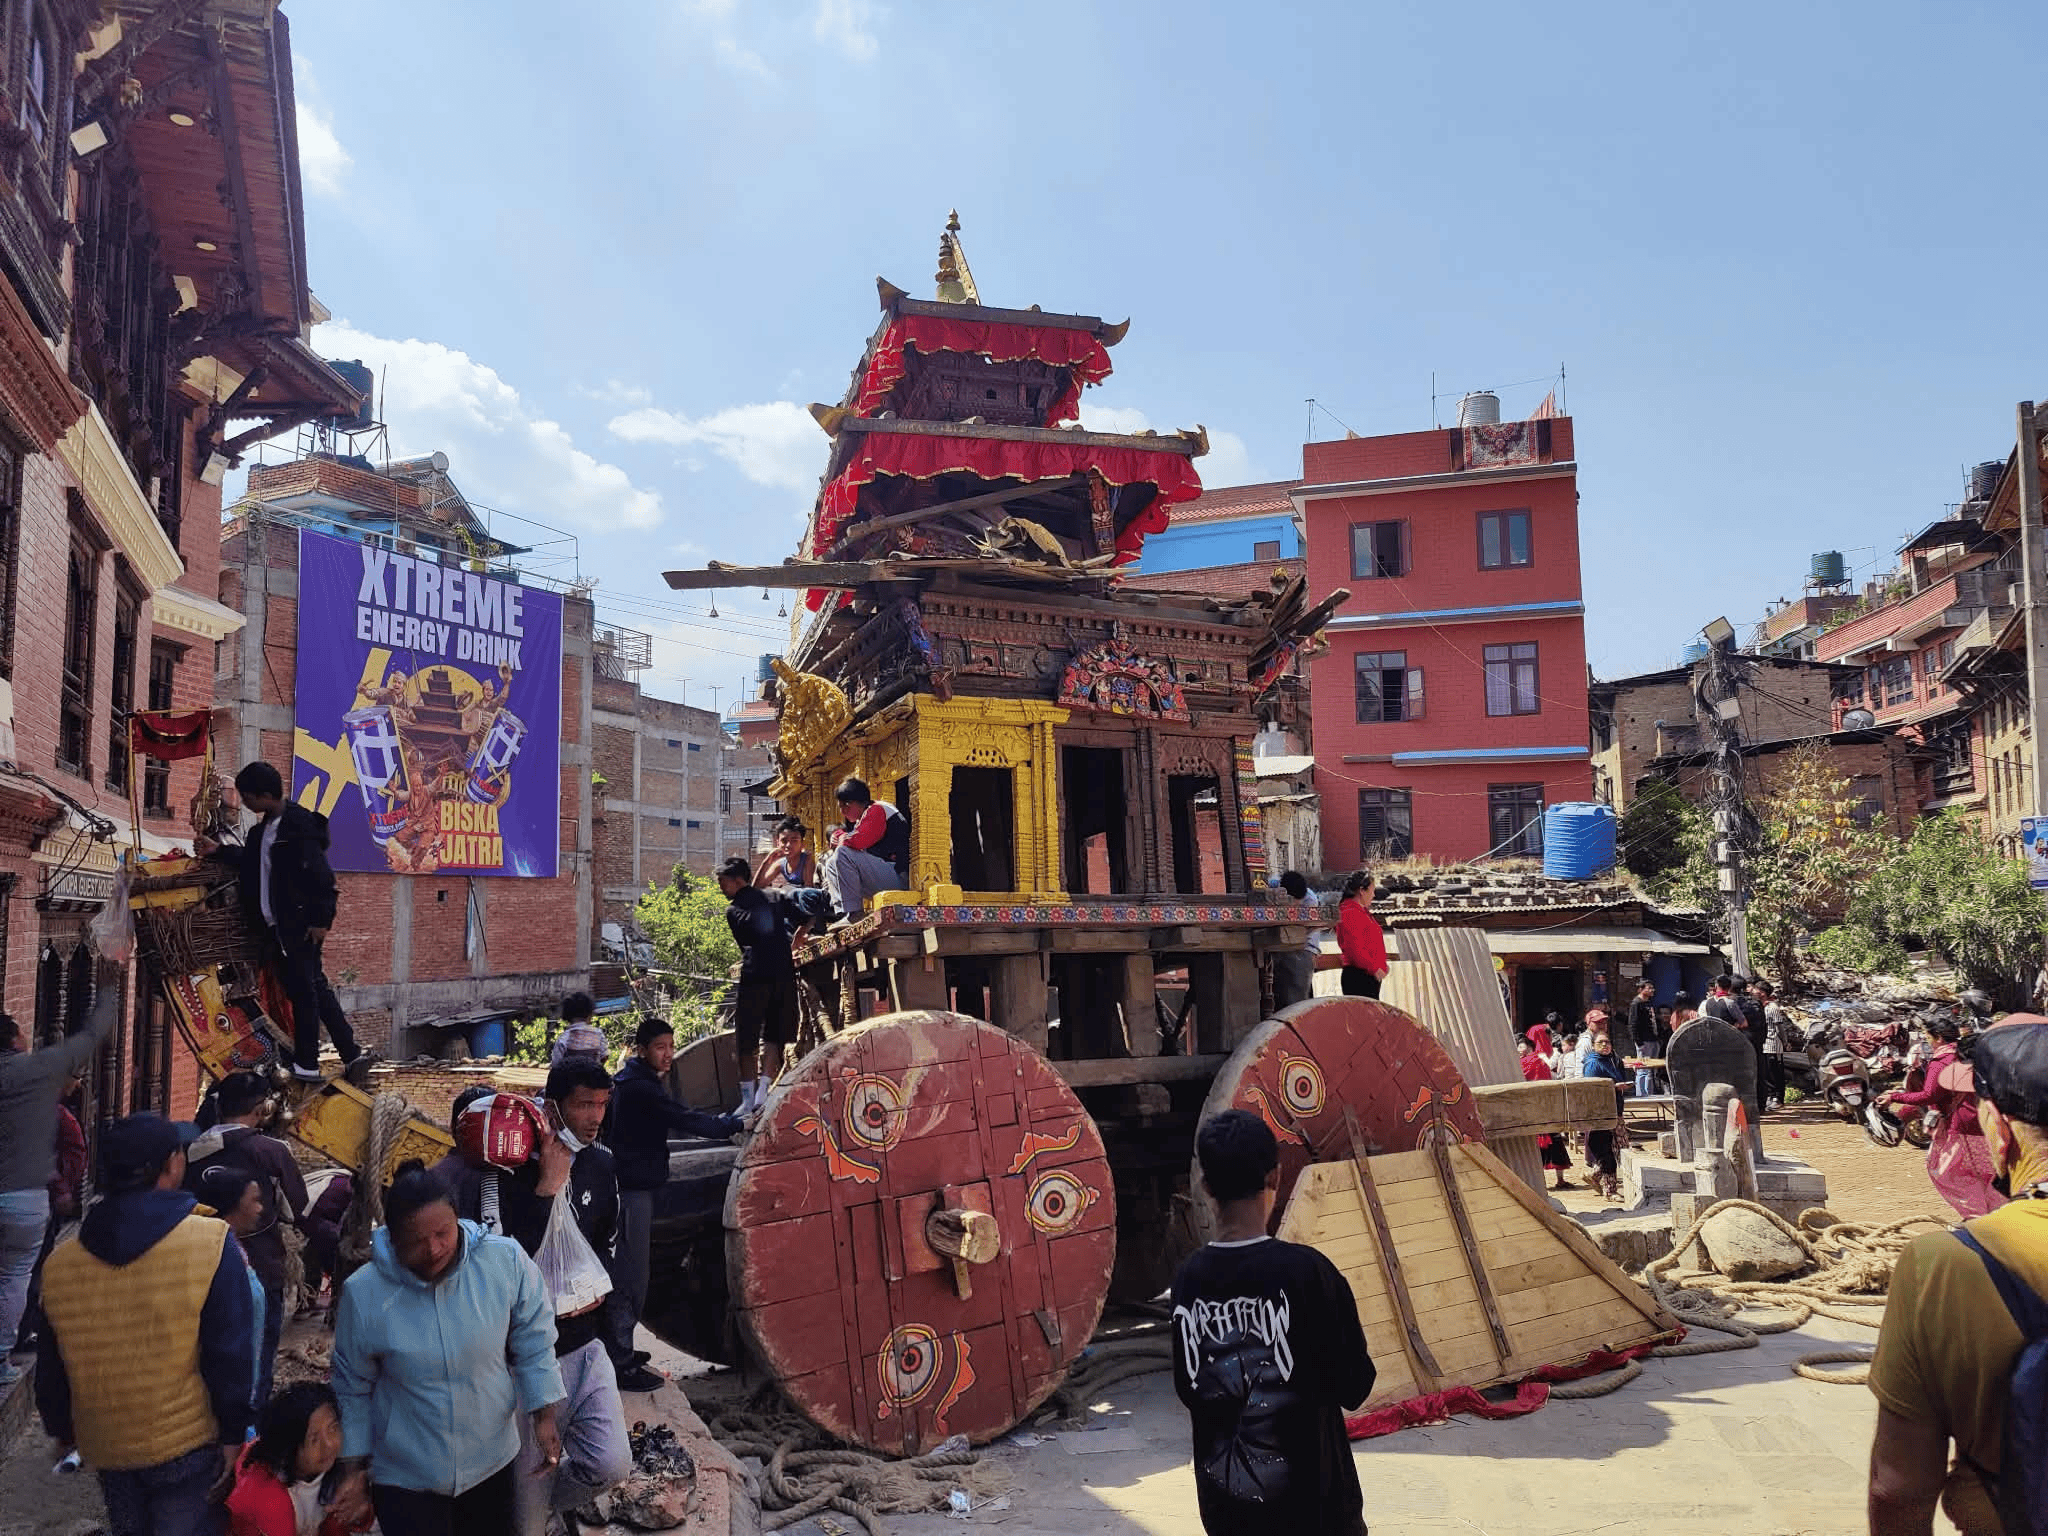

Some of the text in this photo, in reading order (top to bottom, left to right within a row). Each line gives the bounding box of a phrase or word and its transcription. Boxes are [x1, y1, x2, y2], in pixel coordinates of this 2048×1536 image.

[358, 544, 524, 638] XTREME
[357, 605, 523, 671] ENERGY DRINK
[441, 800, 499, 834] BISKA
[439, 834, 504, 866] JATRA
